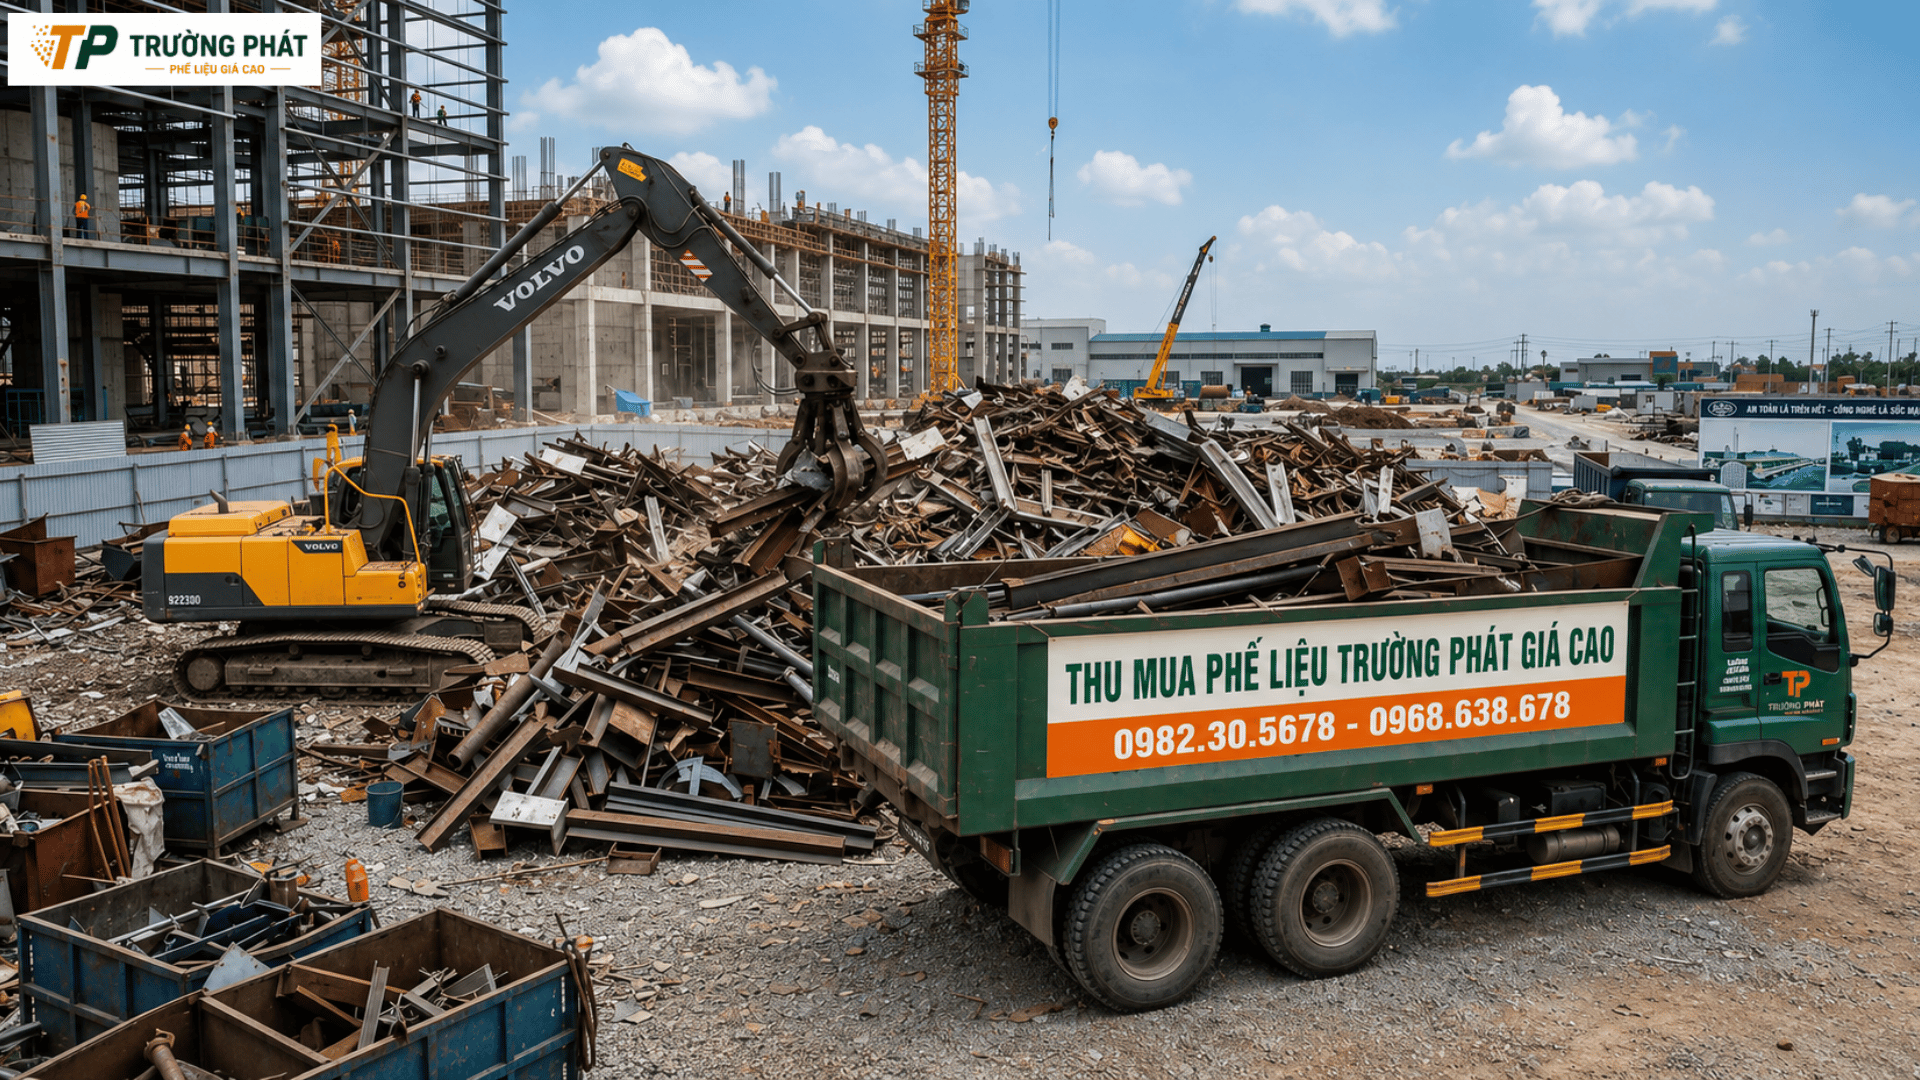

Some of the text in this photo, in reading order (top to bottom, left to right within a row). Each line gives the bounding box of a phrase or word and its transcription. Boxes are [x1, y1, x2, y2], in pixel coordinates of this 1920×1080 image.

[493, 244, 586, 312] VOLVO
[304, 542, 339, 551] VOLVO
[1065, 620, 1615, 705] THU MUA PHẾ LIỆU TRƯỜNG PHÁT GIÁ CAO
[1781, 670, 1811, 698] TP
[1113, 711, 1336, 760] 0982.30.5678
[1369, 691, 1571, 737] 0968.638.678
